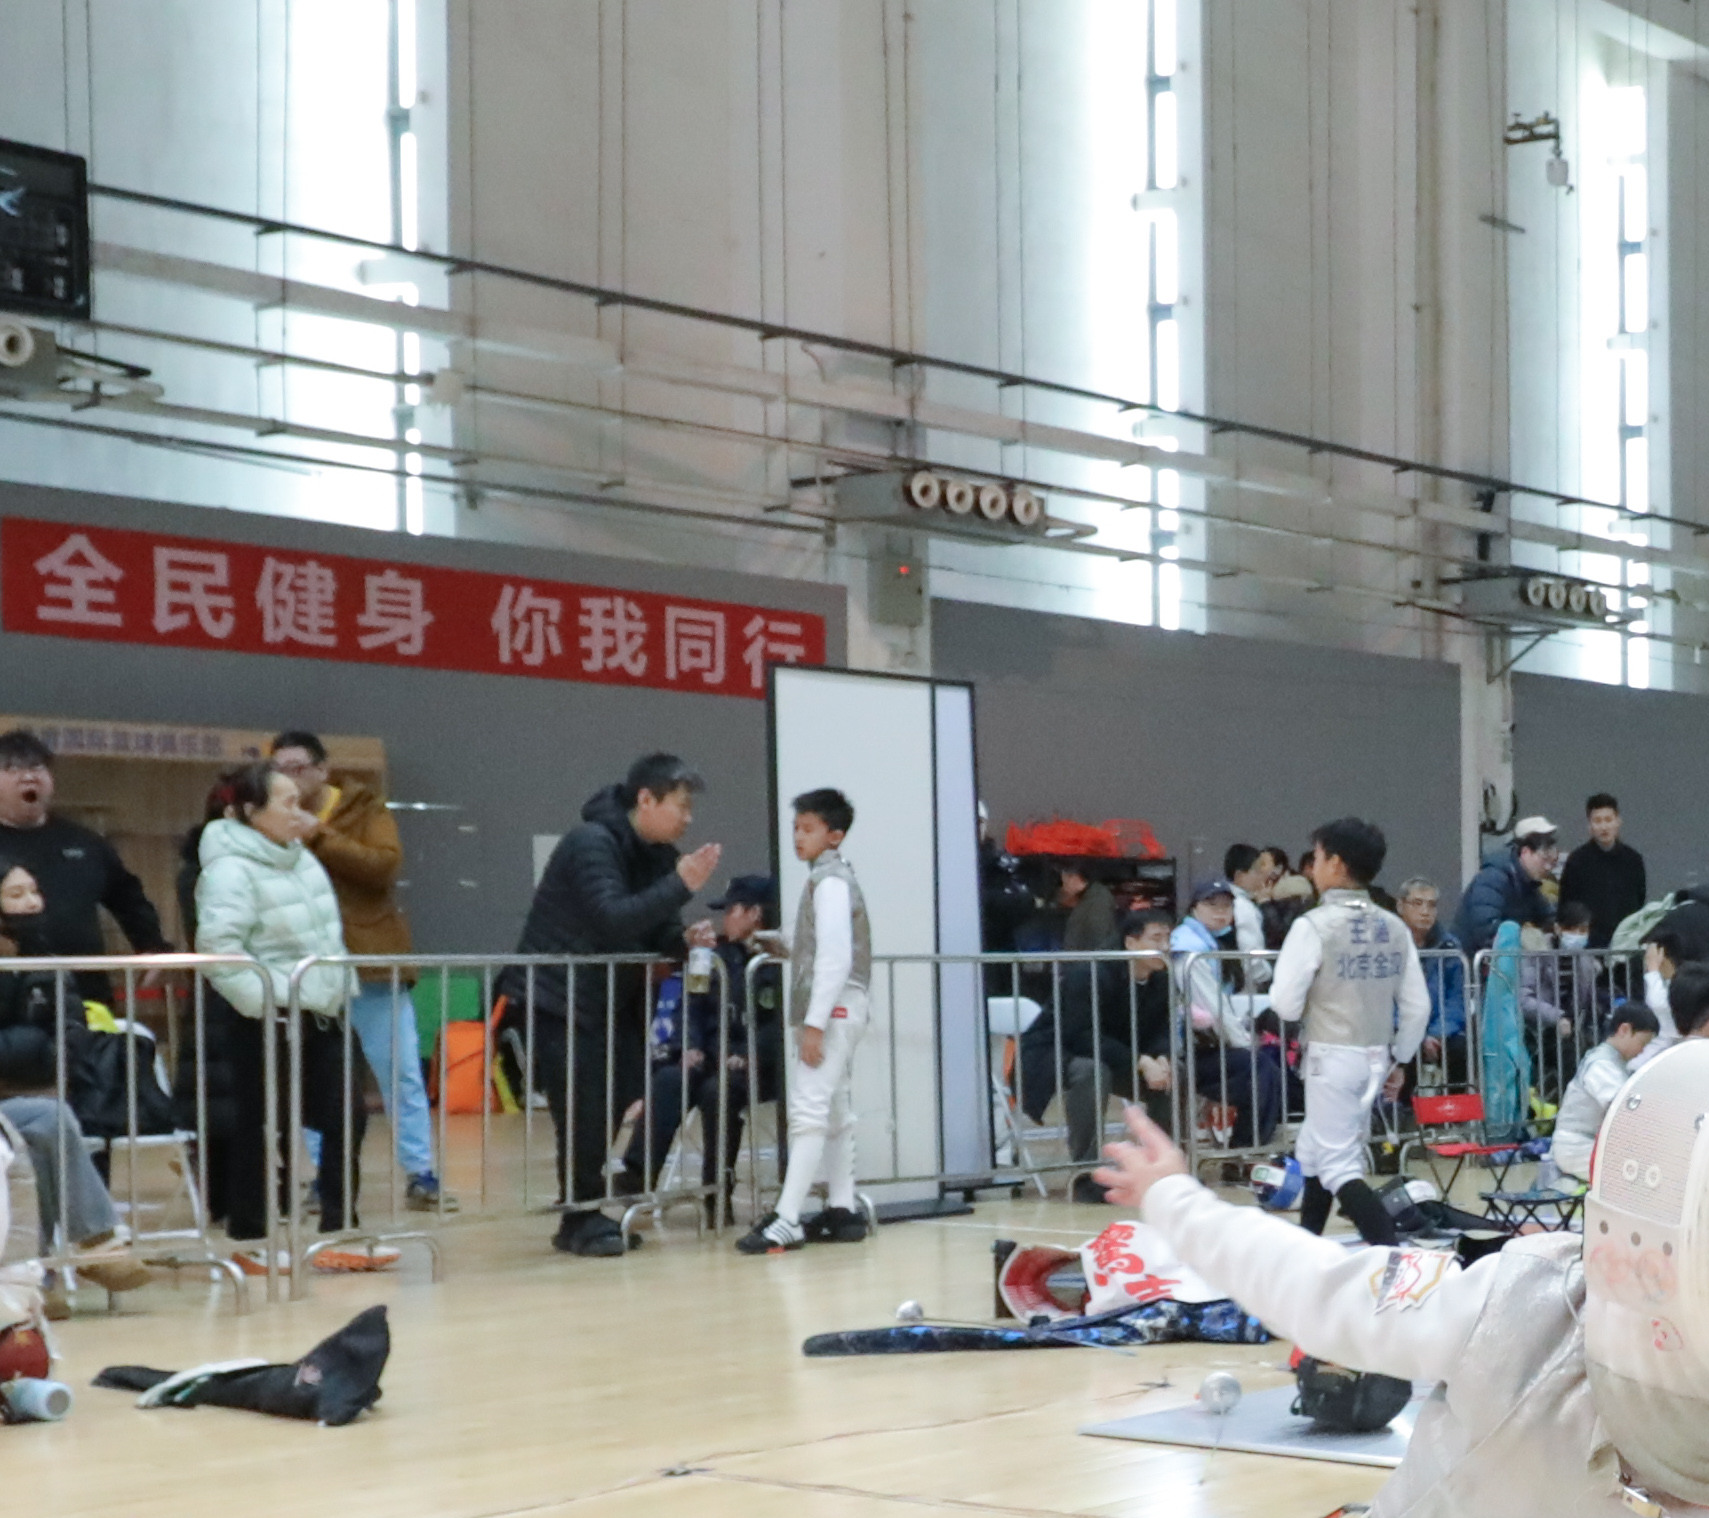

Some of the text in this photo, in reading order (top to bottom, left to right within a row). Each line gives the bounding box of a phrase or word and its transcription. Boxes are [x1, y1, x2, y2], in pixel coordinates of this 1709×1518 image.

[33, 532, 806, 691] 全民健身 你我同行
